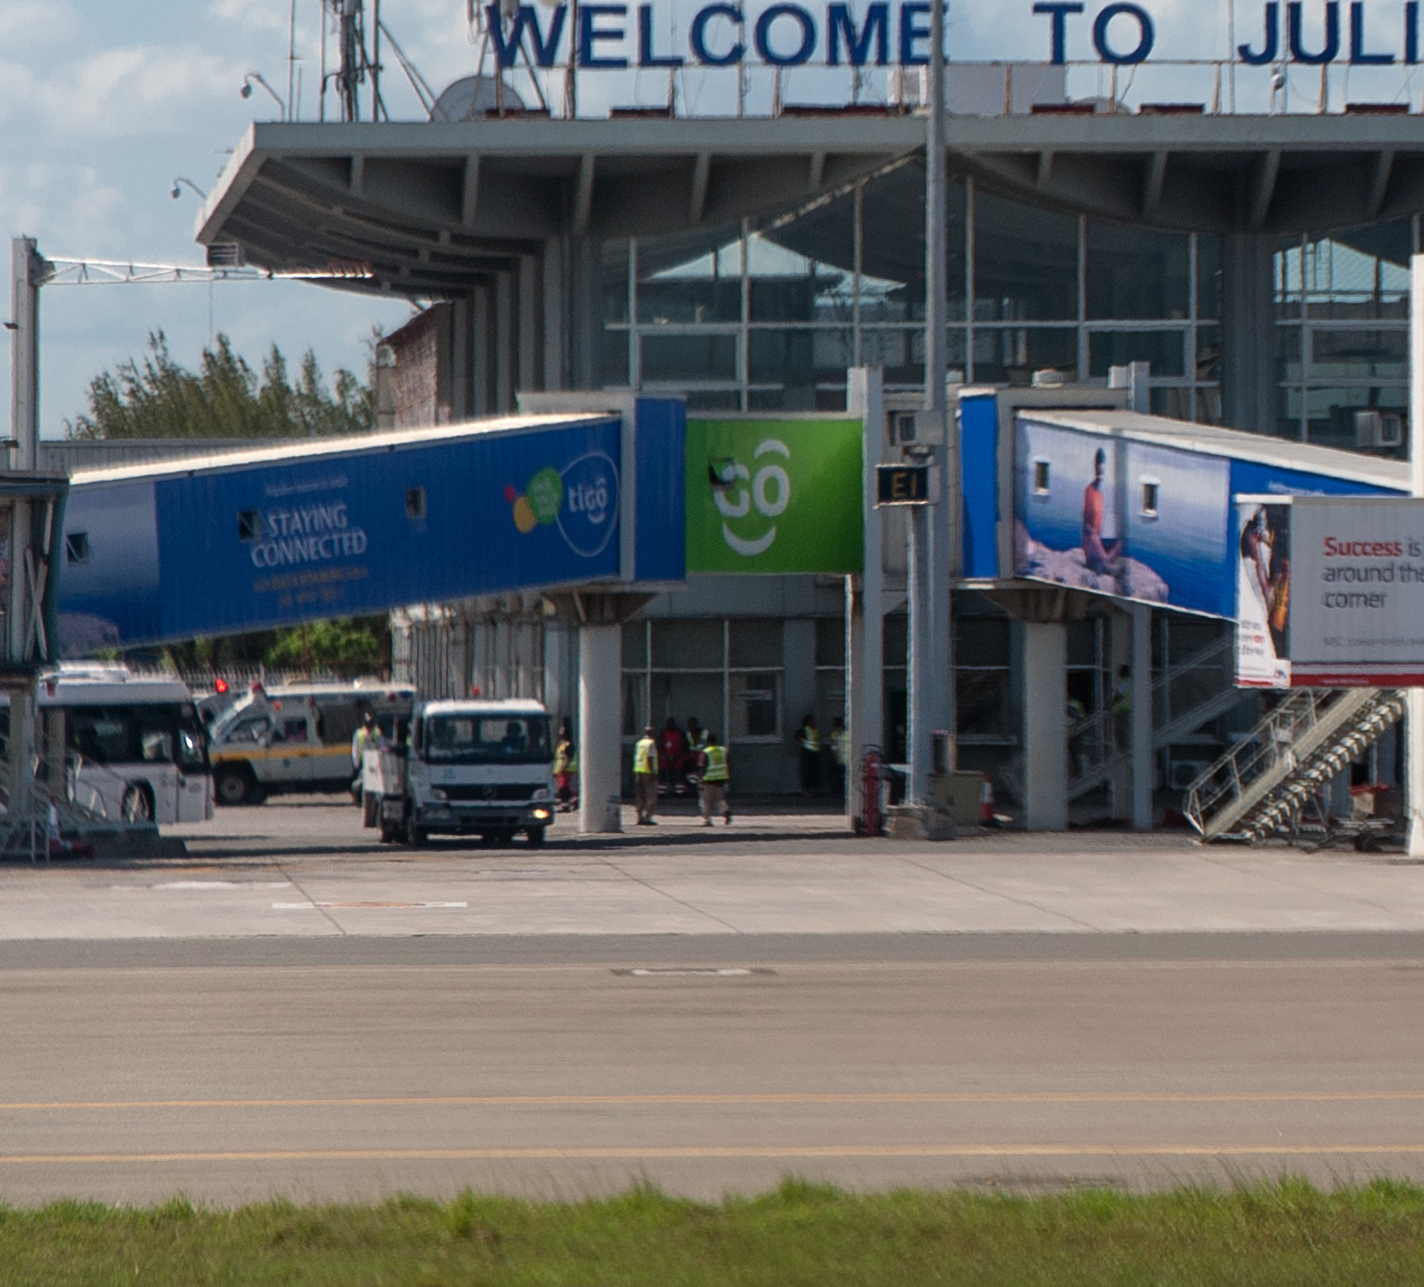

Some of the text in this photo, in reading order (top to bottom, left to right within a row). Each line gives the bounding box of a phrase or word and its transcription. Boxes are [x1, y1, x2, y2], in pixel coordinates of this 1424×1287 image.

[486, 1, 948, 68] WELCOME
[1032, 1, 1155, 66] TO
[266, 499, 349, 539] STAYING
[250, 526, 368, 569] CONNECTED
[1323, 536, 1402, 557] Success
[1406, 536, 1421, 558] is
[1322, 562, 1395, 583] around
[1323, 592, 1386, 608] corner
